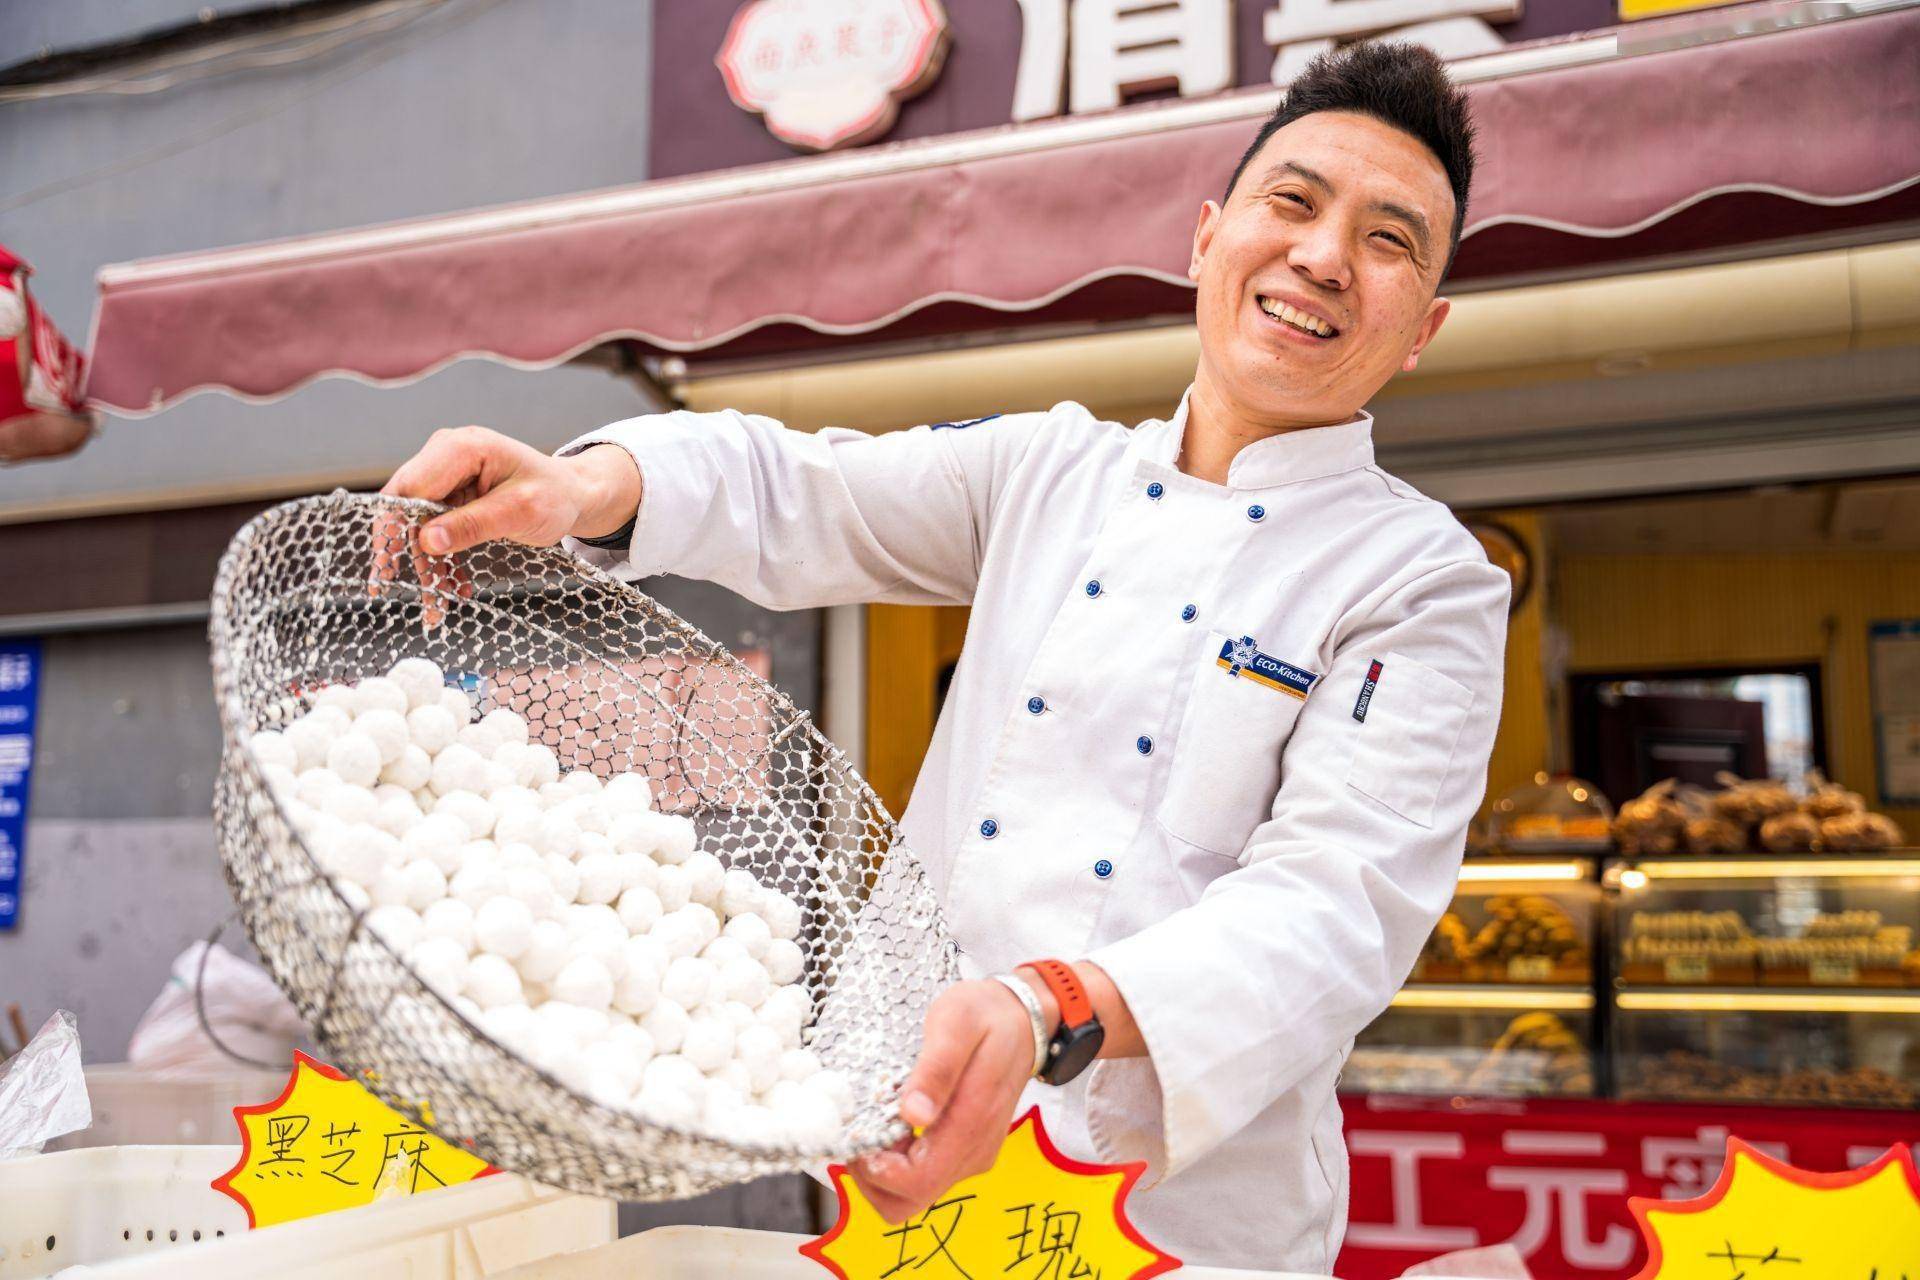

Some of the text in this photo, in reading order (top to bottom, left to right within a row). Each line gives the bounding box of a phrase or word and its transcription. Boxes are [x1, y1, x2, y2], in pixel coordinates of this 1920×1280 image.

[1255, 657, 1310, 686] ECO-Kitchen
[255, 1115, 448, 1194] 黑芝麻
[880, 1193, 1101, 1280] 玫瑰
